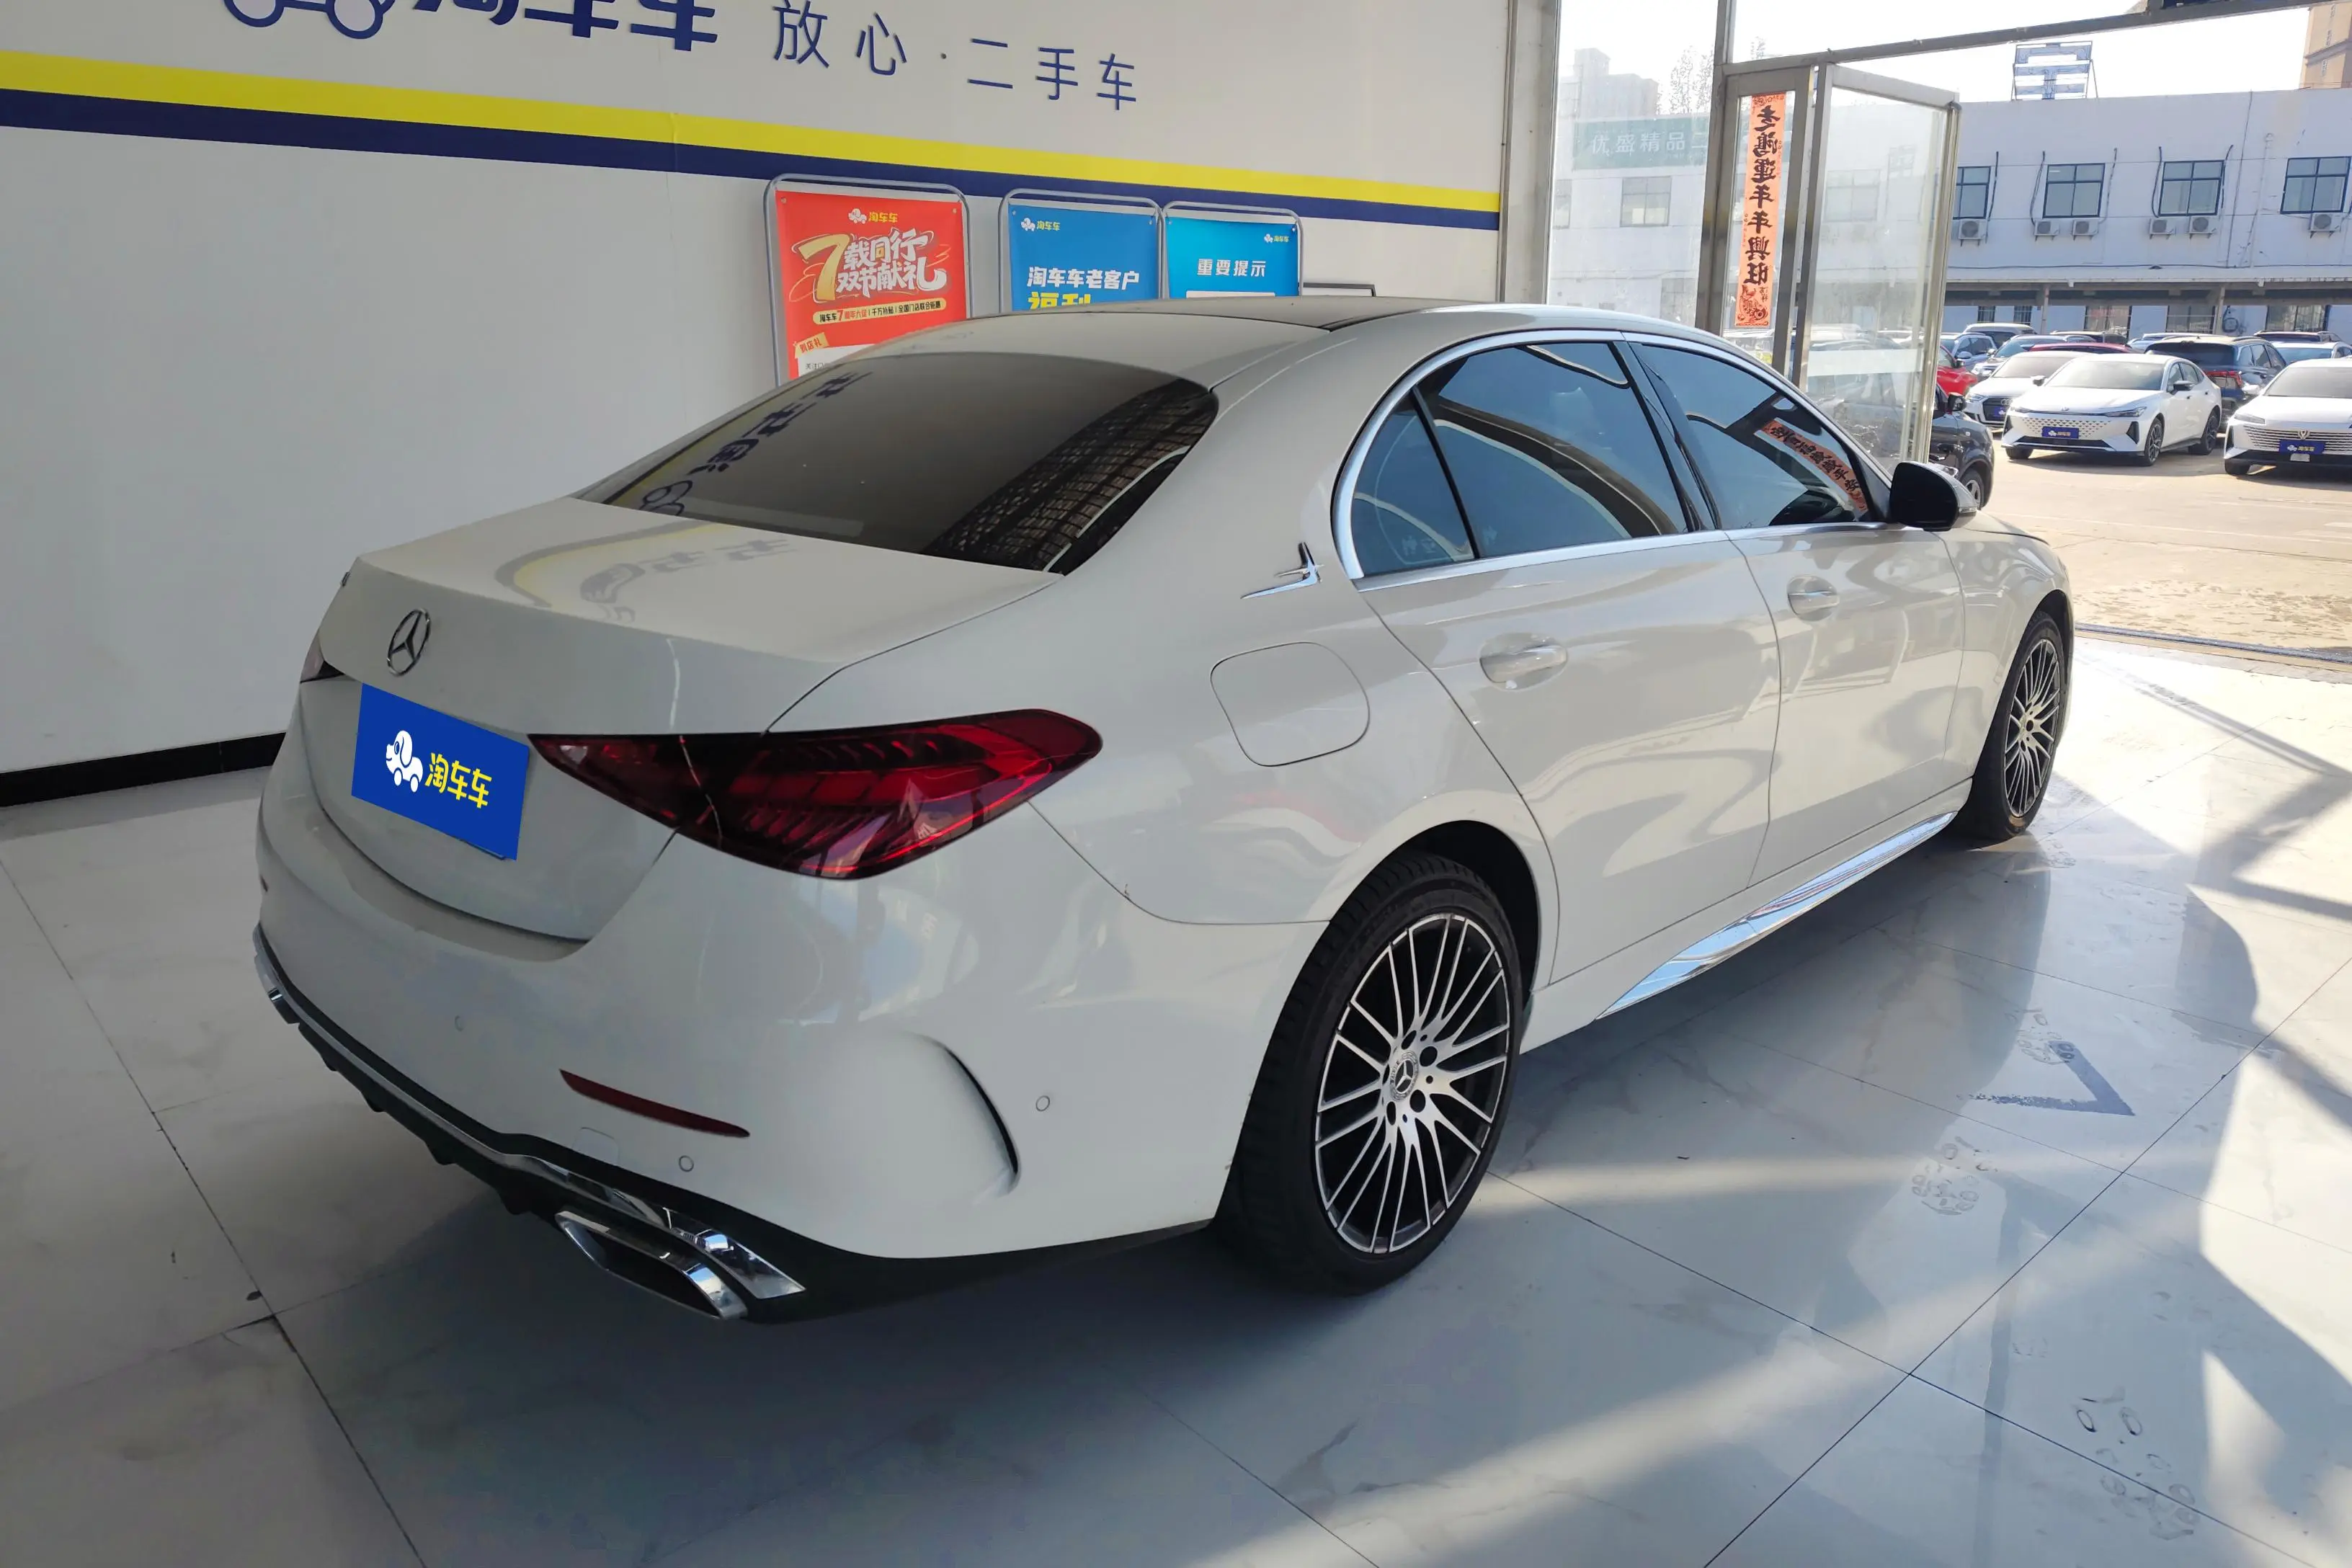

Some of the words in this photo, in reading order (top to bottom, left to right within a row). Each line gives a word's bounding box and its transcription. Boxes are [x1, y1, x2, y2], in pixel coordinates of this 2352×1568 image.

[868, 211, 899, 223] 淘车车
[1036, 220, 1061, 231] 淘车车
[1197, 258, 1267, 277] 重要提示
[1027, 267, 1140, 290] 淘车车老客户
[424, 752, 492, 809] 淘车车
